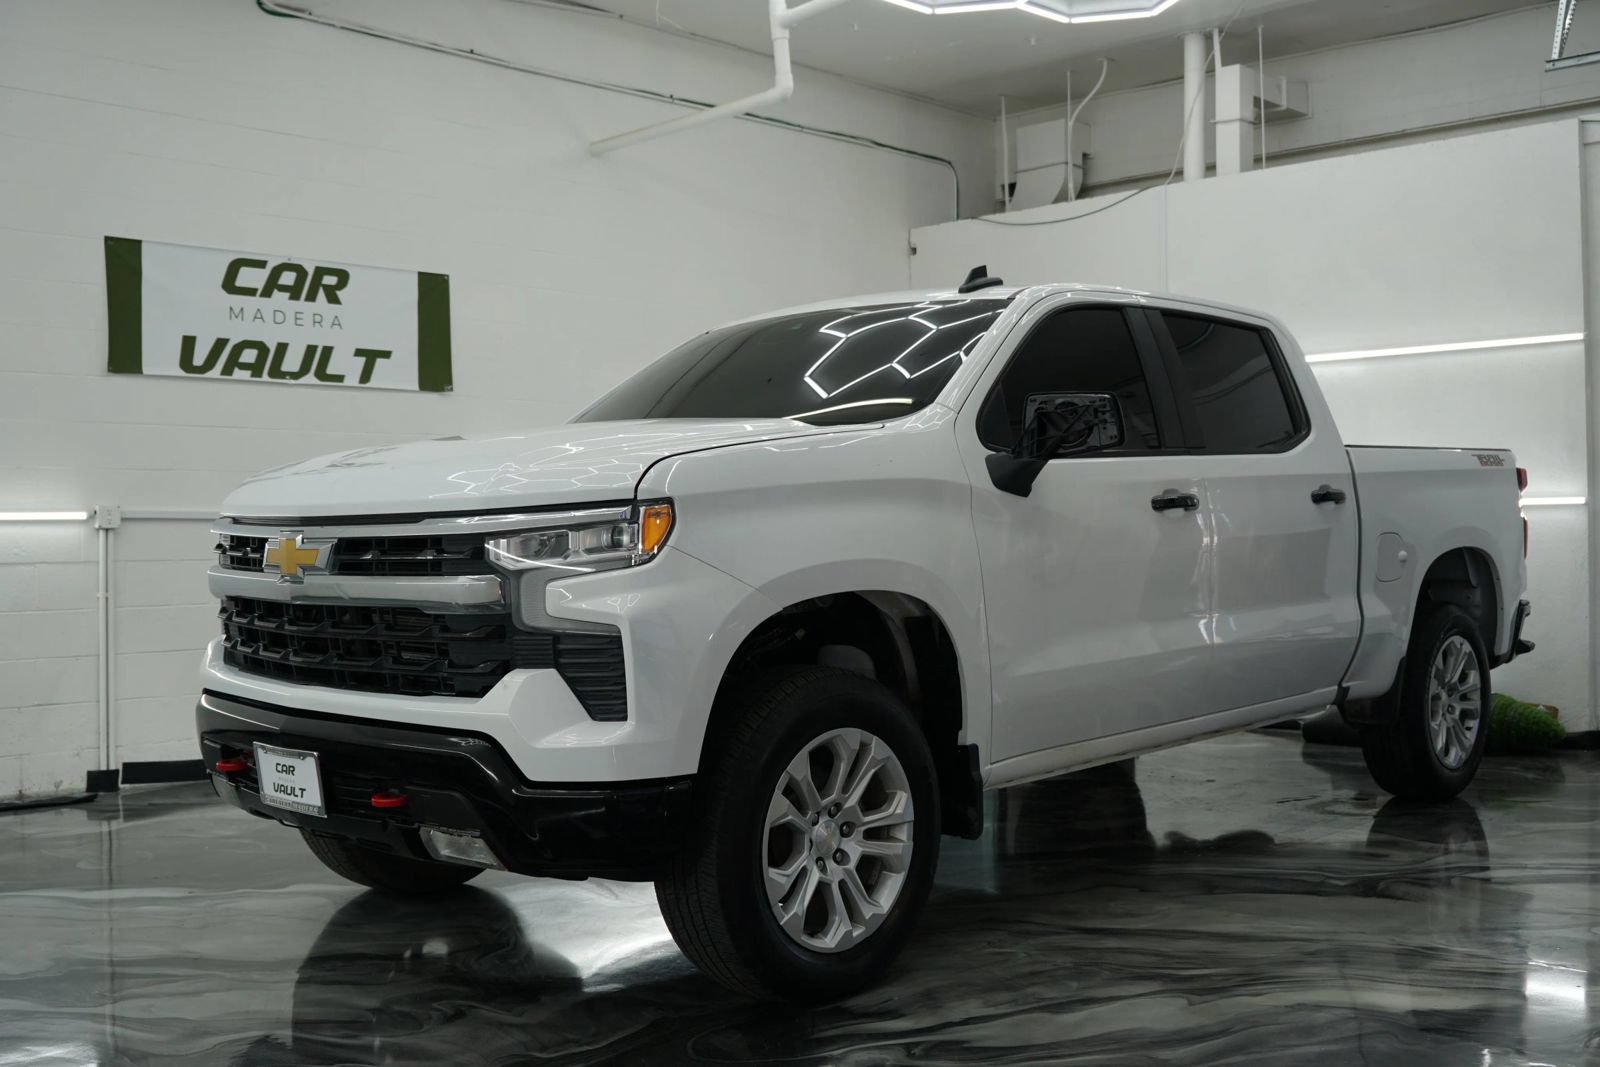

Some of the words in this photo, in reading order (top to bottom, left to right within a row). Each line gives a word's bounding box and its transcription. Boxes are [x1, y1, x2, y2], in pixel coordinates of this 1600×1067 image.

[221, 257, 350, 305] CAR
[228, 306, 344, 330] MADERA
[179, 335, 392, 384] VAULT
[275, 762, 296, 776] CAR
[273, 782, 306, 798] VAULT
